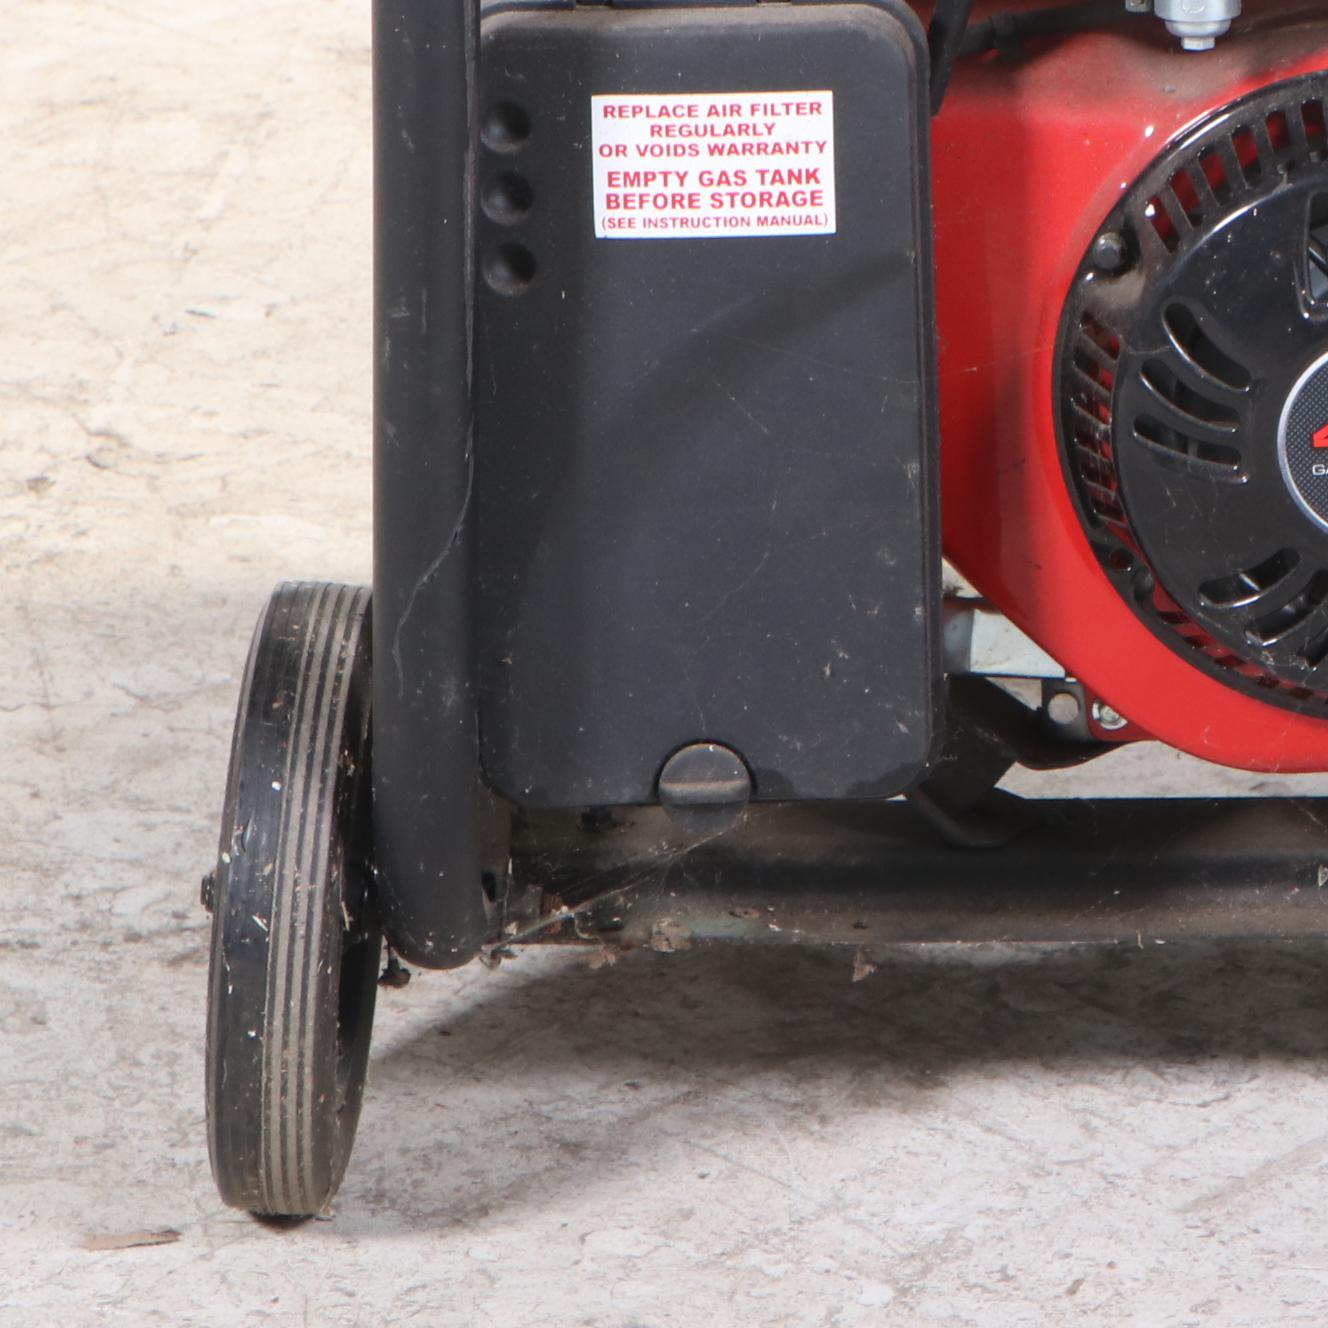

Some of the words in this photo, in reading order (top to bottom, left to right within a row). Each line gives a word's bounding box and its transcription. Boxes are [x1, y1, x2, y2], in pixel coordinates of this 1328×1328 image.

[603, 104, 699, 119] REPLACE
[706, 103, 742, 117] AIR
[750, 102, 823, 116] FILTER
[650, 123, 776, 138] REGULARLY
[599, 144, 628, 158] OR
[635, 143, 700, 158] VOIDS
[707, 141, 828, 157] WARRANTY
[607, 171, 688, 188] EMPTY
[698, 170, 747, 187] GAS
[755, 168, 821, 185] TANK
[606, 192, 701, 210] BEFORE
[710, 190, 823, 209] STORAGE
[601, 217, 638, 231] (SEE
[642, 216, 751, 229] INSTRUCTION
[757, 213, 829, 228] MANUAL)
